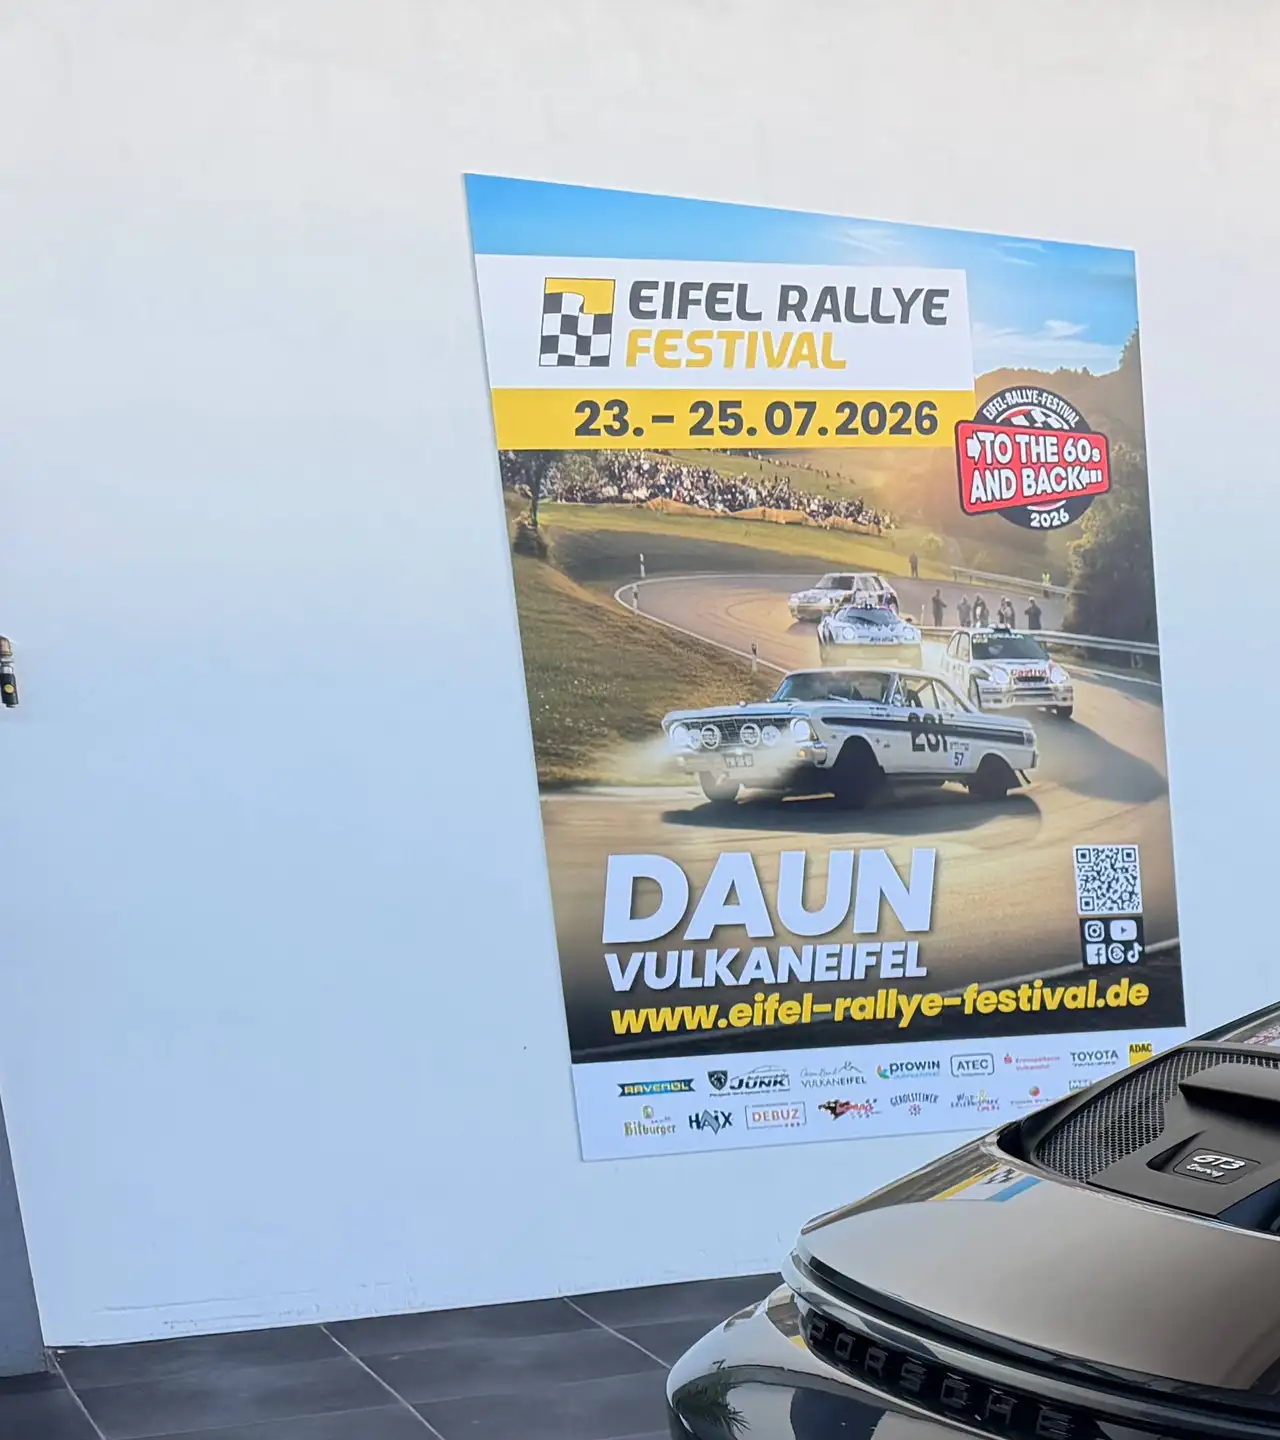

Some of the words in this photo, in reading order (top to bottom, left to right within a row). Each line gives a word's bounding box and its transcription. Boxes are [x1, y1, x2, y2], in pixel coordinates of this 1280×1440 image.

[628, 280, 763, 322] EIFEL
[777, 284, 950, 327] RALLYE
[625, 328, 847, 370] FESTIVAL
[976, 432, 1013, 464] TO
[1015, 434, 1059, 463] THE
[1063, 438, 1100, 463] 60s
[970, 468, 1017, 504] AND
[1022, 466, 1083, 497] BACK
[1030, 513, 1070, 528] 2026
[954, 751, 965, 767] 57
[602, 847, 937, 944] DAUN
[604, 940, 927, 992] VULKANEIFEL
[611, 978, 1149, 1036] www.eifel-rallye-festival.de
[1070, 1050, 1119, 1061] TOYOTA
[1129, 1042, 1152, 1053] ADAC
[957, 1059, 989, 1071] ATEC
[624, 1081, 689, 1094] RAVENOL
[729, 1078, 786, 1090] JUNK
[752, 1108, 800, 1123] DEBUZ
[624, 1120, 676, 1137] Bitburger
[1193, 1155, 1246, 1170] GT3
